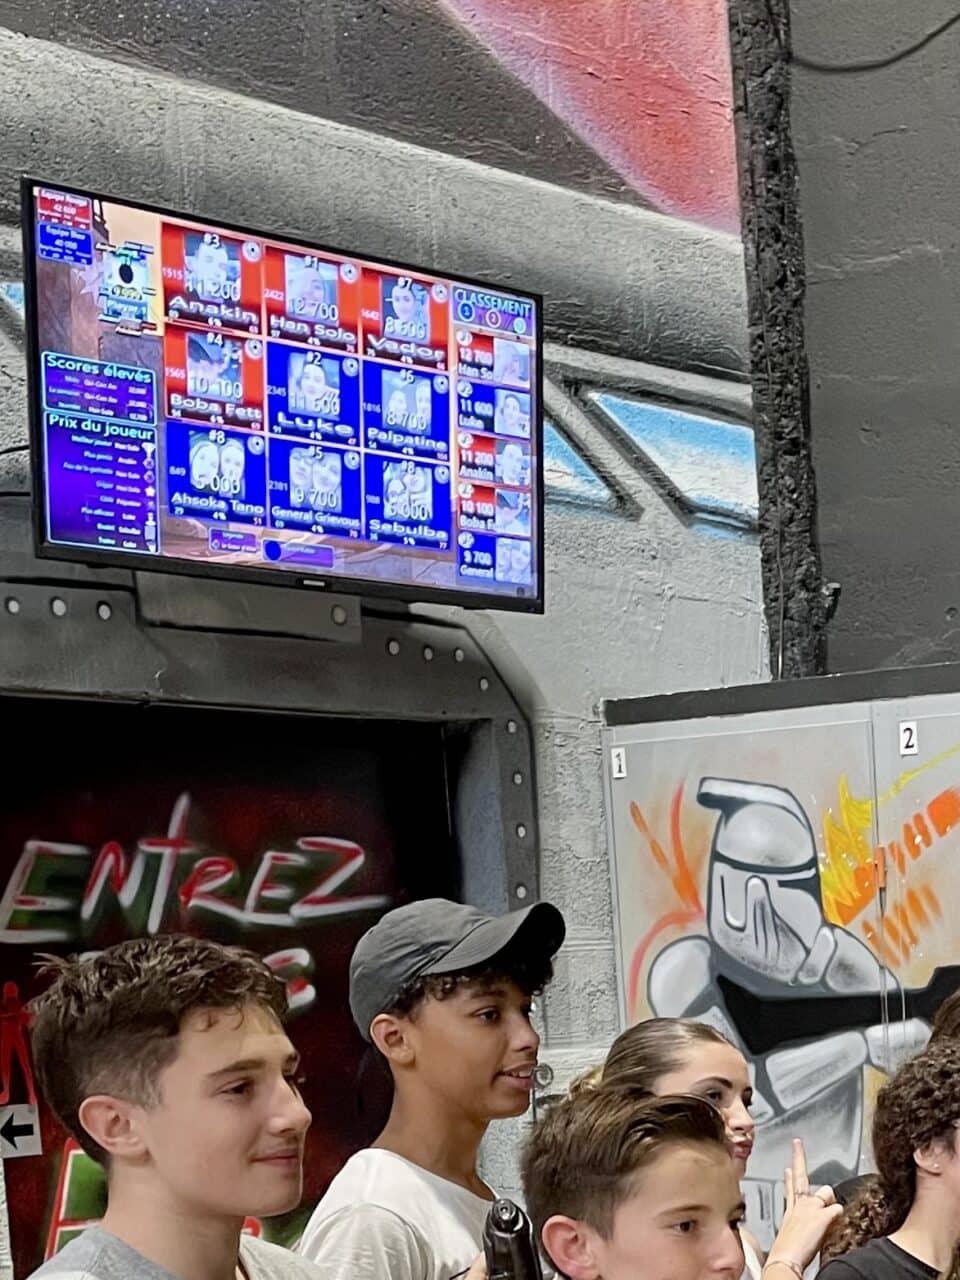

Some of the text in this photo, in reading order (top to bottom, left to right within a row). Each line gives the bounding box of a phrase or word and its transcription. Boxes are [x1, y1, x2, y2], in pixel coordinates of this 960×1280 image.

[168, 296, 259, 324] Anakin
[454, 288, 531, 318] CLASSEMENT
[270, 314, 357, 344] Han Solo
[368, 334, 445, 361] Vador
[47, 355, 152, 383] Scores élevés
[458, 363, 480, 378] Han
[170, 393, 222, 415] Boba
[225, 403, 262, 420] Fett
[49, 414, 153, 440] Prix du joueur
[277, 411, 355, 437] Luke
[367, 427, 448, 452] Palpatine
[171, 492, 265, 517] Ahsoka Tano
[271, 505, 361, 529] General Grievous
[369, 519, 449, 542] Sebulba
[903, 727, 915, 749] 2
[615, 751, 624, 774] 1
